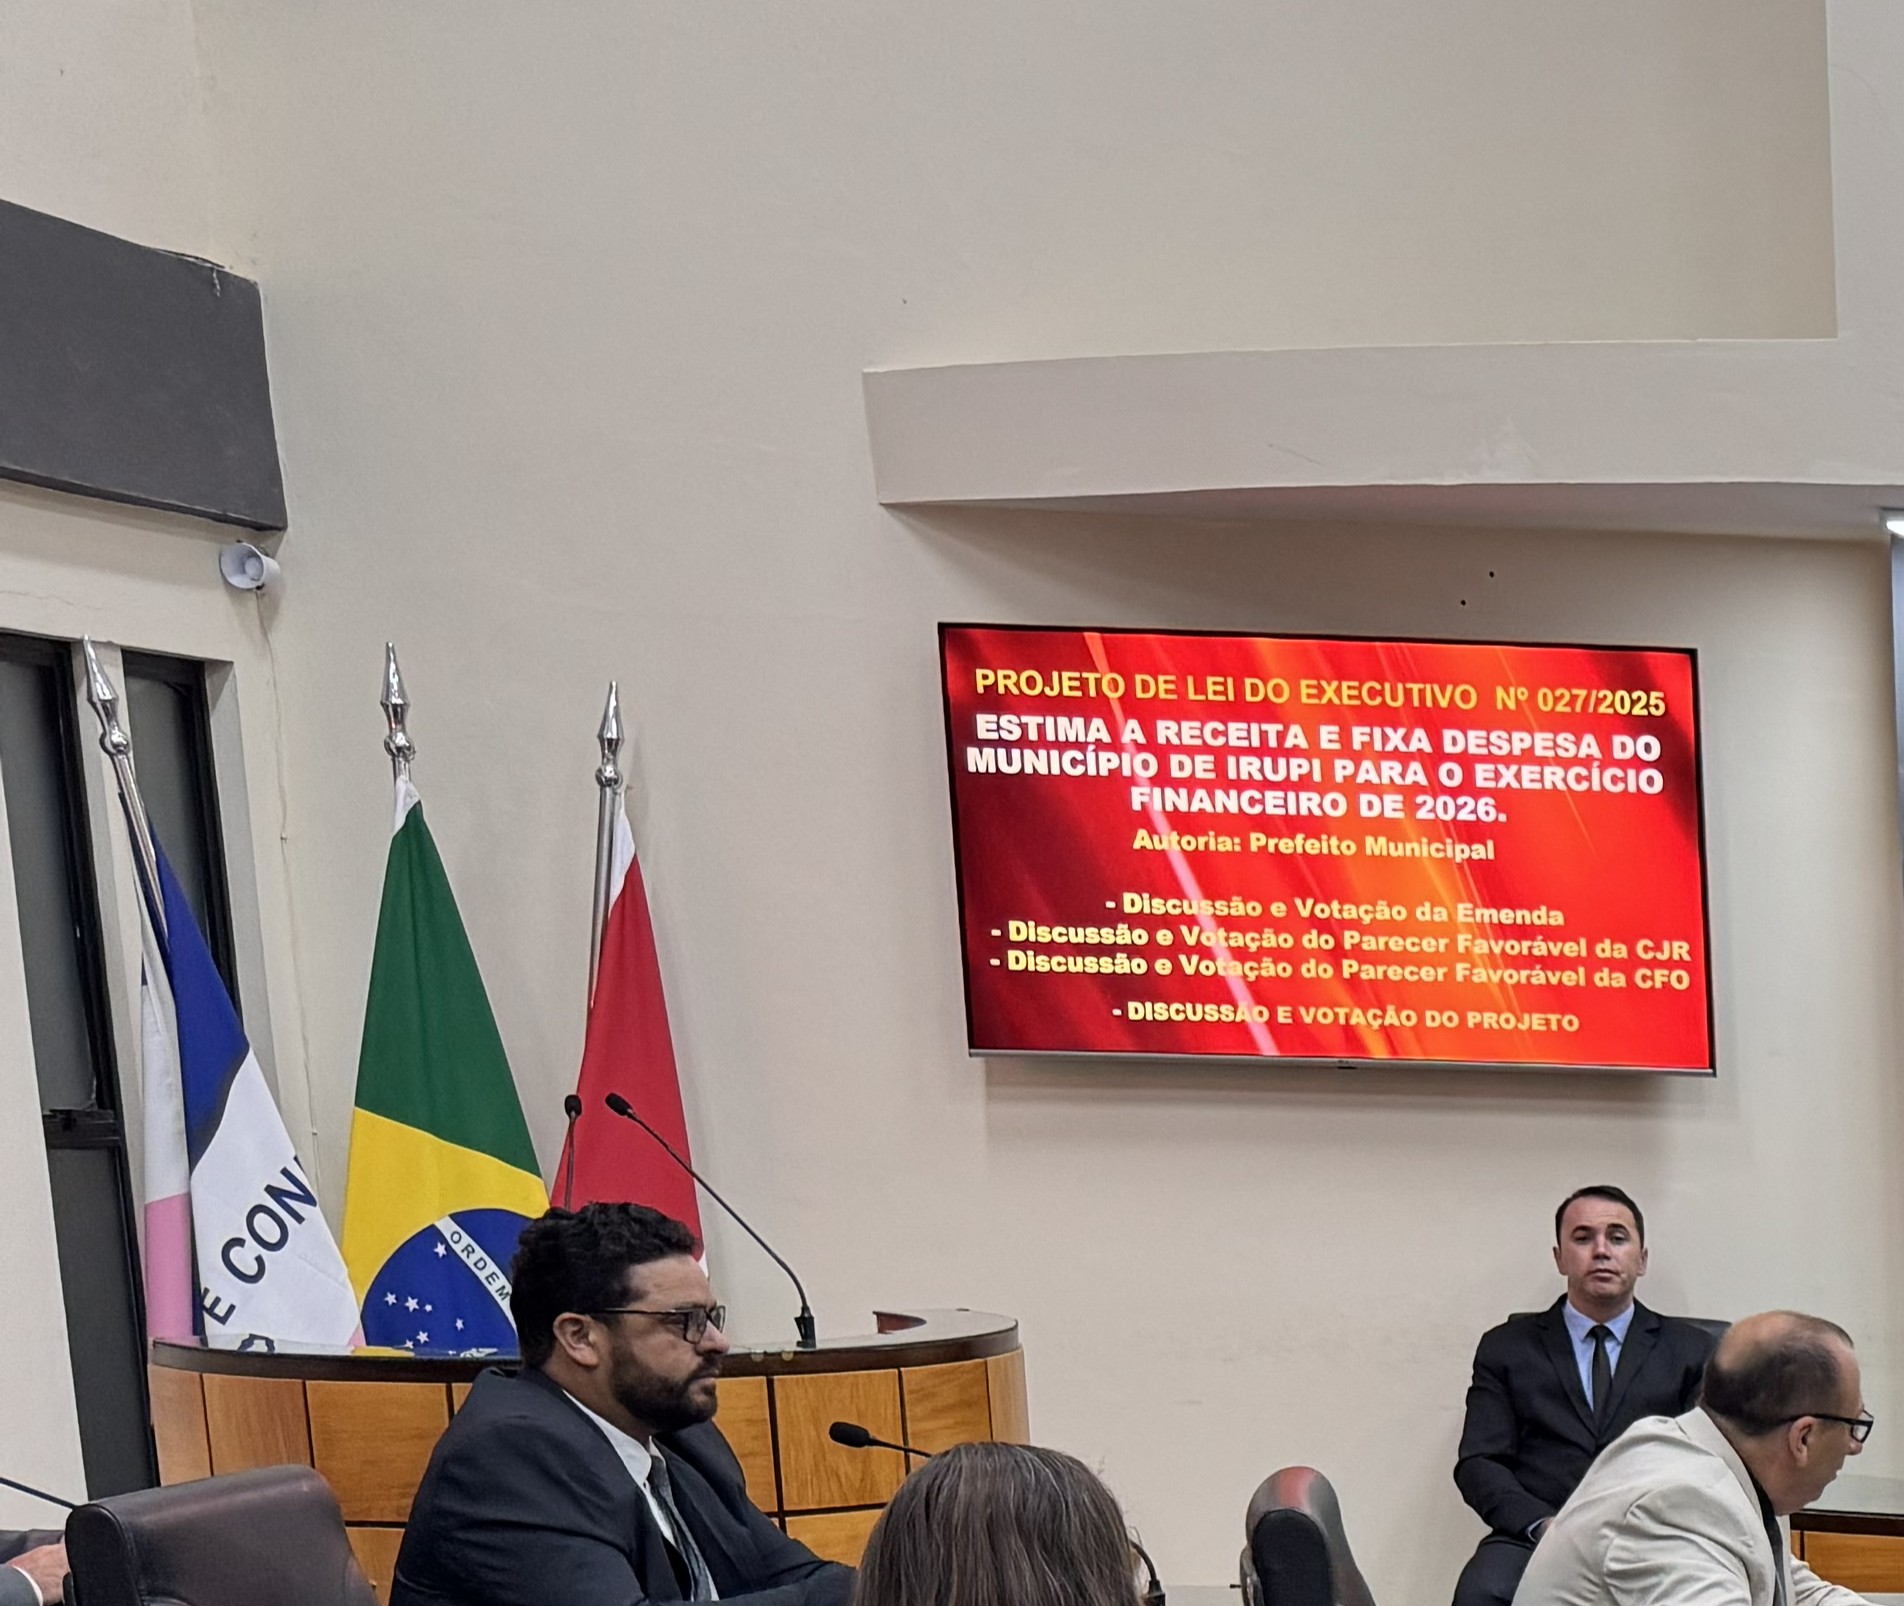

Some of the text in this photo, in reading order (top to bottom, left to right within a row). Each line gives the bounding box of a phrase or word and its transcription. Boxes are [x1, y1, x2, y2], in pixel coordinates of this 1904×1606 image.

[975, 668, 1124, 696] PROJETO
[1135, 673, 1175, 697] DE
[1187, 675, 1233, 699] LEI
[1244, 676, 1289, 701] DO
[1300, 678, 1476, 707] EXECUTIVO
[1537, 687, 1666, 714] 027/2025
[976, 714, 1661, 758] ESTIMA A RECEITA E FIXA DESPESA DO
[967, 745, 1664, 793] MUNICÍPIO DE IRUPI PARA O EXERCÍCIO
[1131, 787, 1507, 821] FINANCEIRO DE 2026.
[1132, 828, 1495, 859] Autoria: Prefeito Municipal
[1123, 893, 1261, 916] Discussão
[1271, 902, 1288, 917] e
[1295, 897, 1406, 925] Votação
[1415, 902, 1449, 920] da
[1458, 904, 1564, 925] Emenda
[1009, 920, 1148, 945] Discussão
[1157, 930, 1173, 945] e
[1180, 925, 1292, 952] Votação
[1300, 929, 1335, 949] do
[1343, 932, 1449, 952] Parecer
[1457, 934, 1589, 957] Favorável
[1595, 938, 1628, 958] da
[1636, 938, 1691, 959] CJR
[1008, 949, 1148, 974] Discussão
[1155, 958, 1172, 974] e
[1179, 954, 1291, 981] Votação
[1300, 958, 1334, 978] do
[1342, 961, 1448, 982] Parecer
[1456, 963, 1587, 986] Favorável
[1594, 967, 1628, 988] da
[1634, 967, 1690, 989] CFO
[1278, 1005, 1292, 1022] E
[1301, 1004, 1417, 1029] VOTAÇÃO
[1425, 1009, 1458, 1027] DO
[1467, 1011, 1580, 1030] PROJETO
[221, 1155, 318, 1285] CON
[449, 1230, 512, 1301] ORDEM
